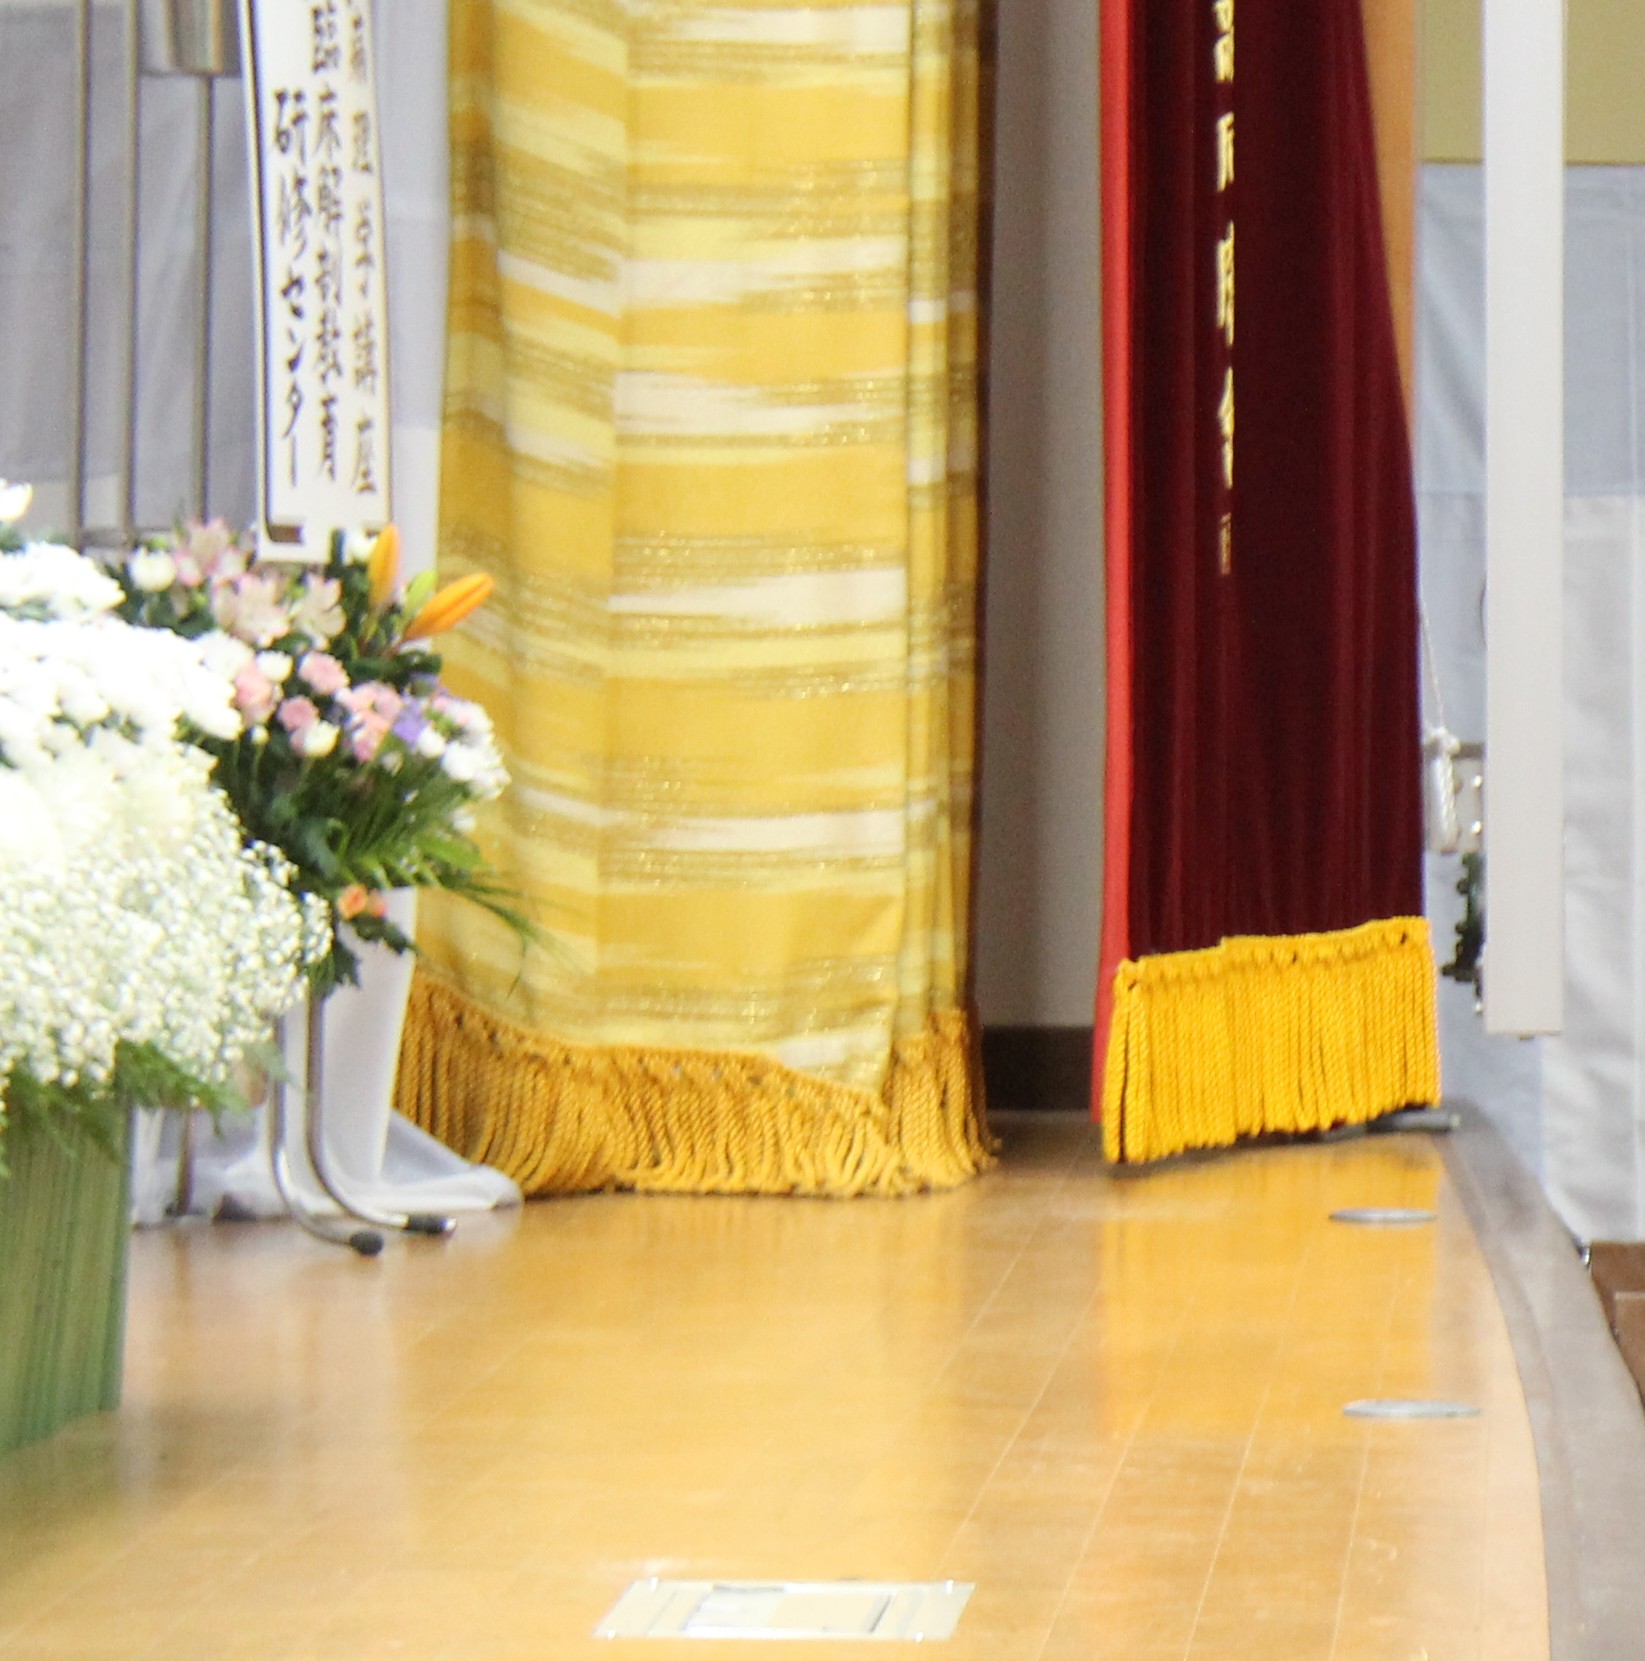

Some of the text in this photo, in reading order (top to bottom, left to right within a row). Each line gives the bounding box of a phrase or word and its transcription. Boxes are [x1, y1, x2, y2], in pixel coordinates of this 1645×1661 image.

[274, 89, 311, 488] 研修センター
